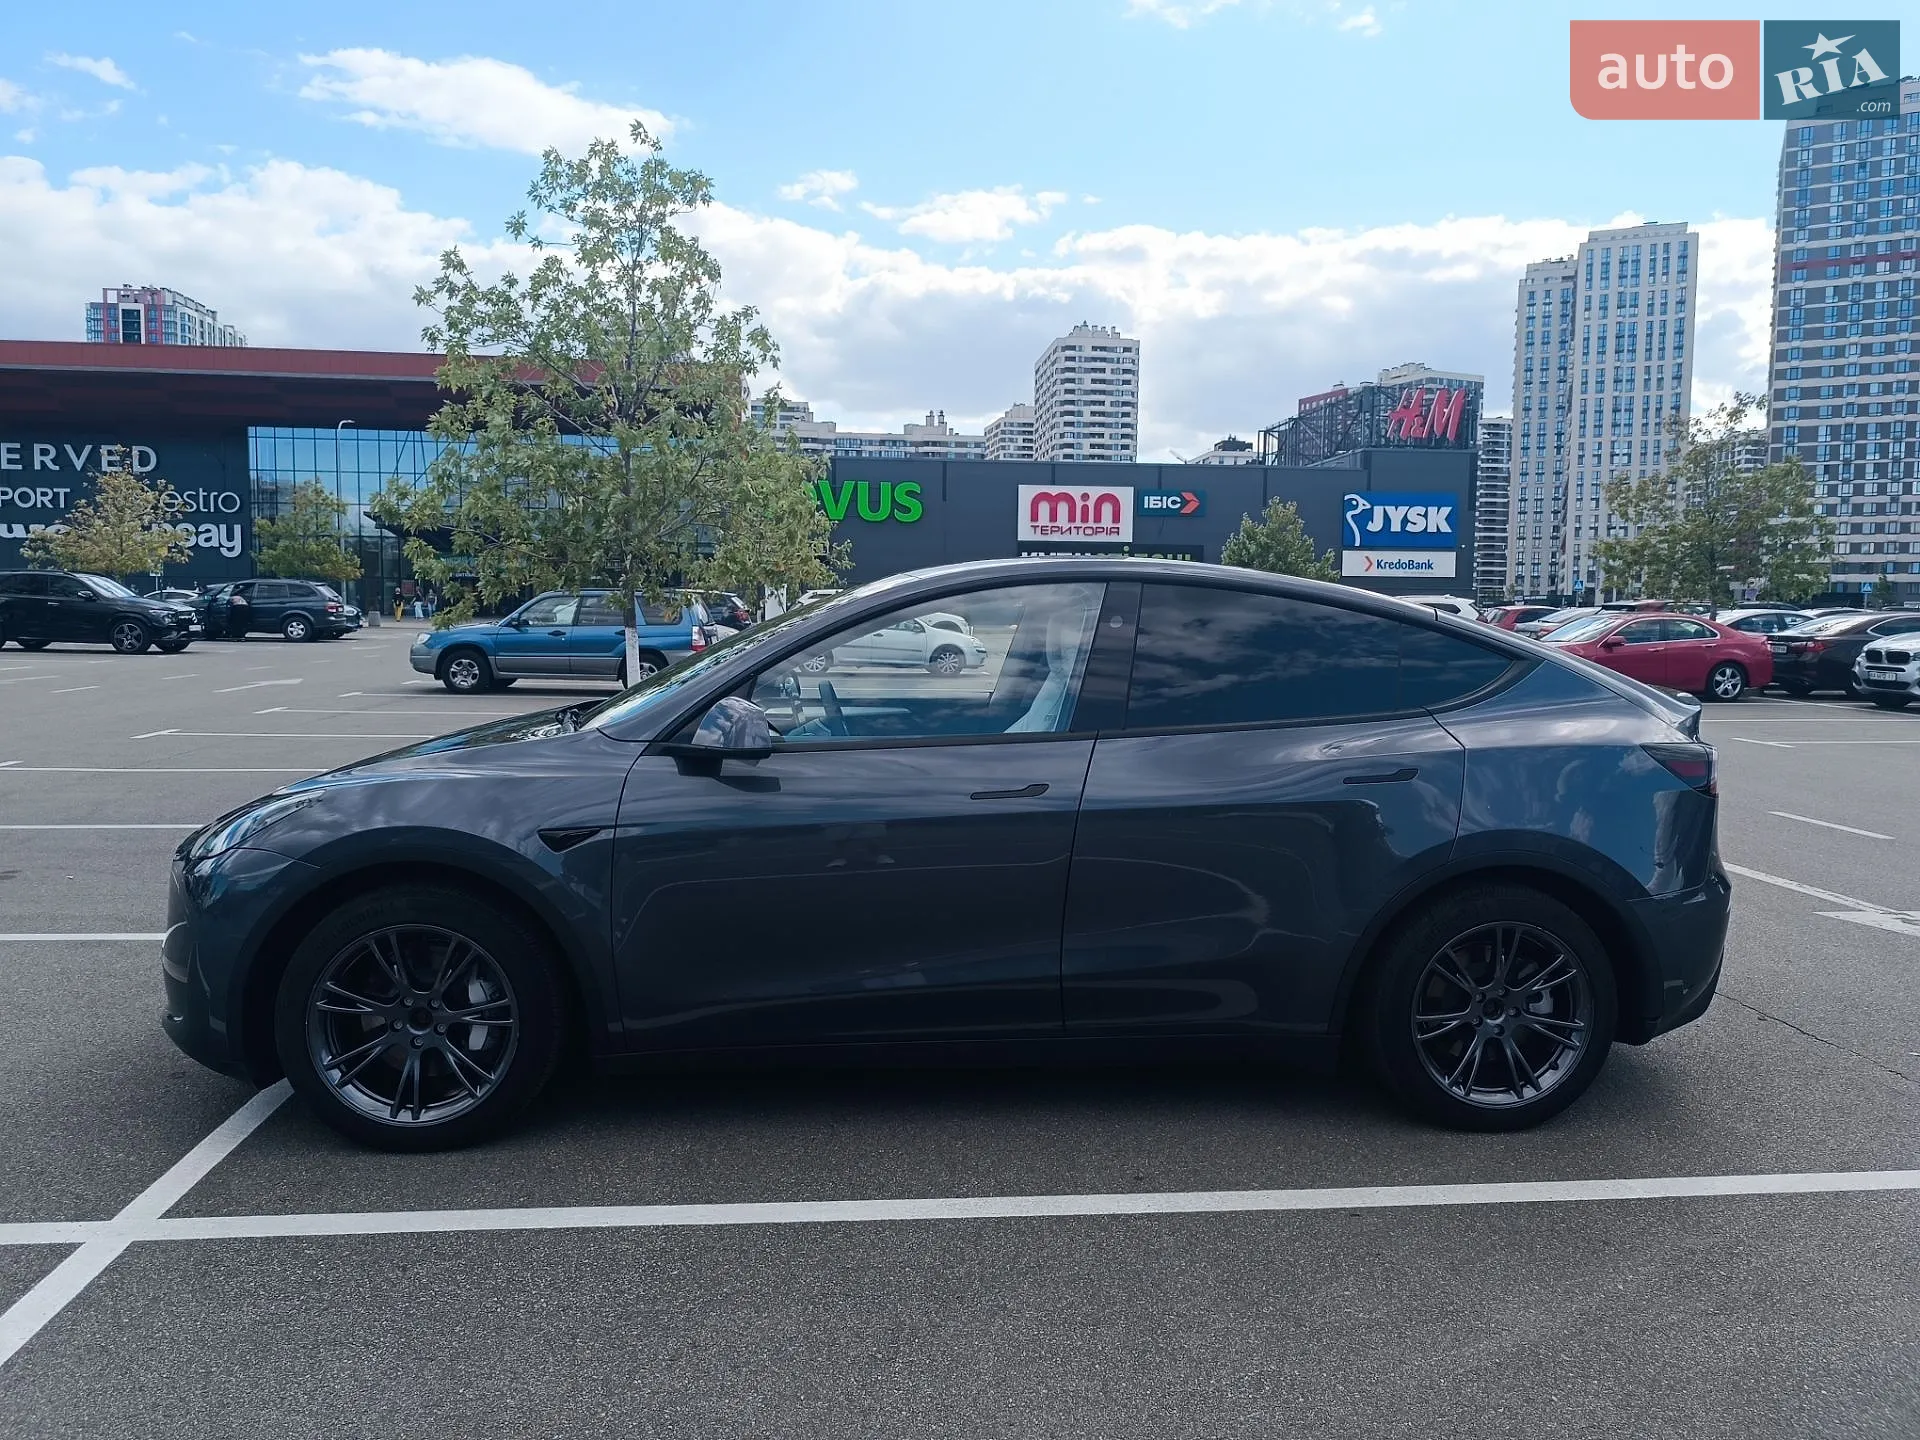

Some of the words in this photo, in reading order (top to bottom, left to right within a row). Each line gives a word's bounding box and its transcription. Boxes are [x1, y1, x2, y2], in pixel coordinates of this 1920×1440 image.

[1386, 387, 1466, 440] H&M
[1367, 505, 1453, 533] JYSK
[1030, 525, 1120, 537] ТЕРИТОРІЯ
[1376, 558, 1434, 571] KredoBank
